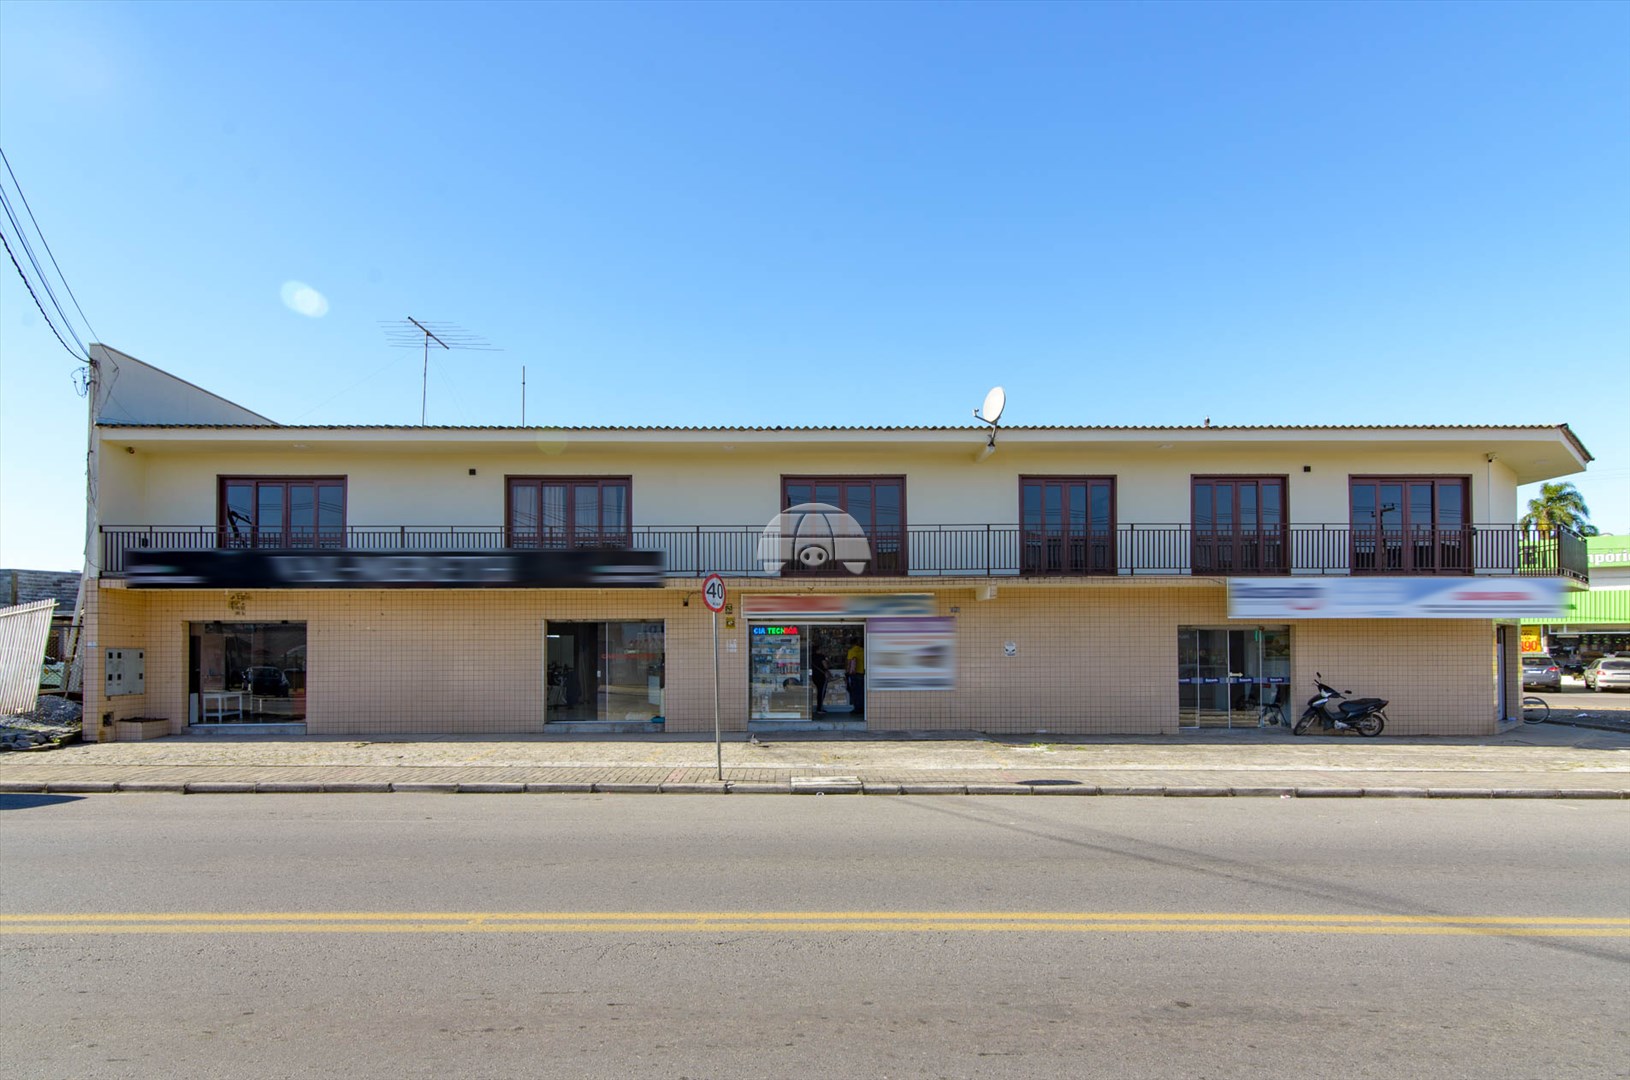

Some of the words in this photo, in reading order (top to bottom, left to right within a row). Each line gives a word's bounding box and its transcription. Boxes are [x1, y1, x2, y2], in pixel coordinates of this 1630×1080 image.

[1588, 550, 1630, 566] póri
[706, 582, 724, 599] 40
[753, 627, 766, 635] CIA
